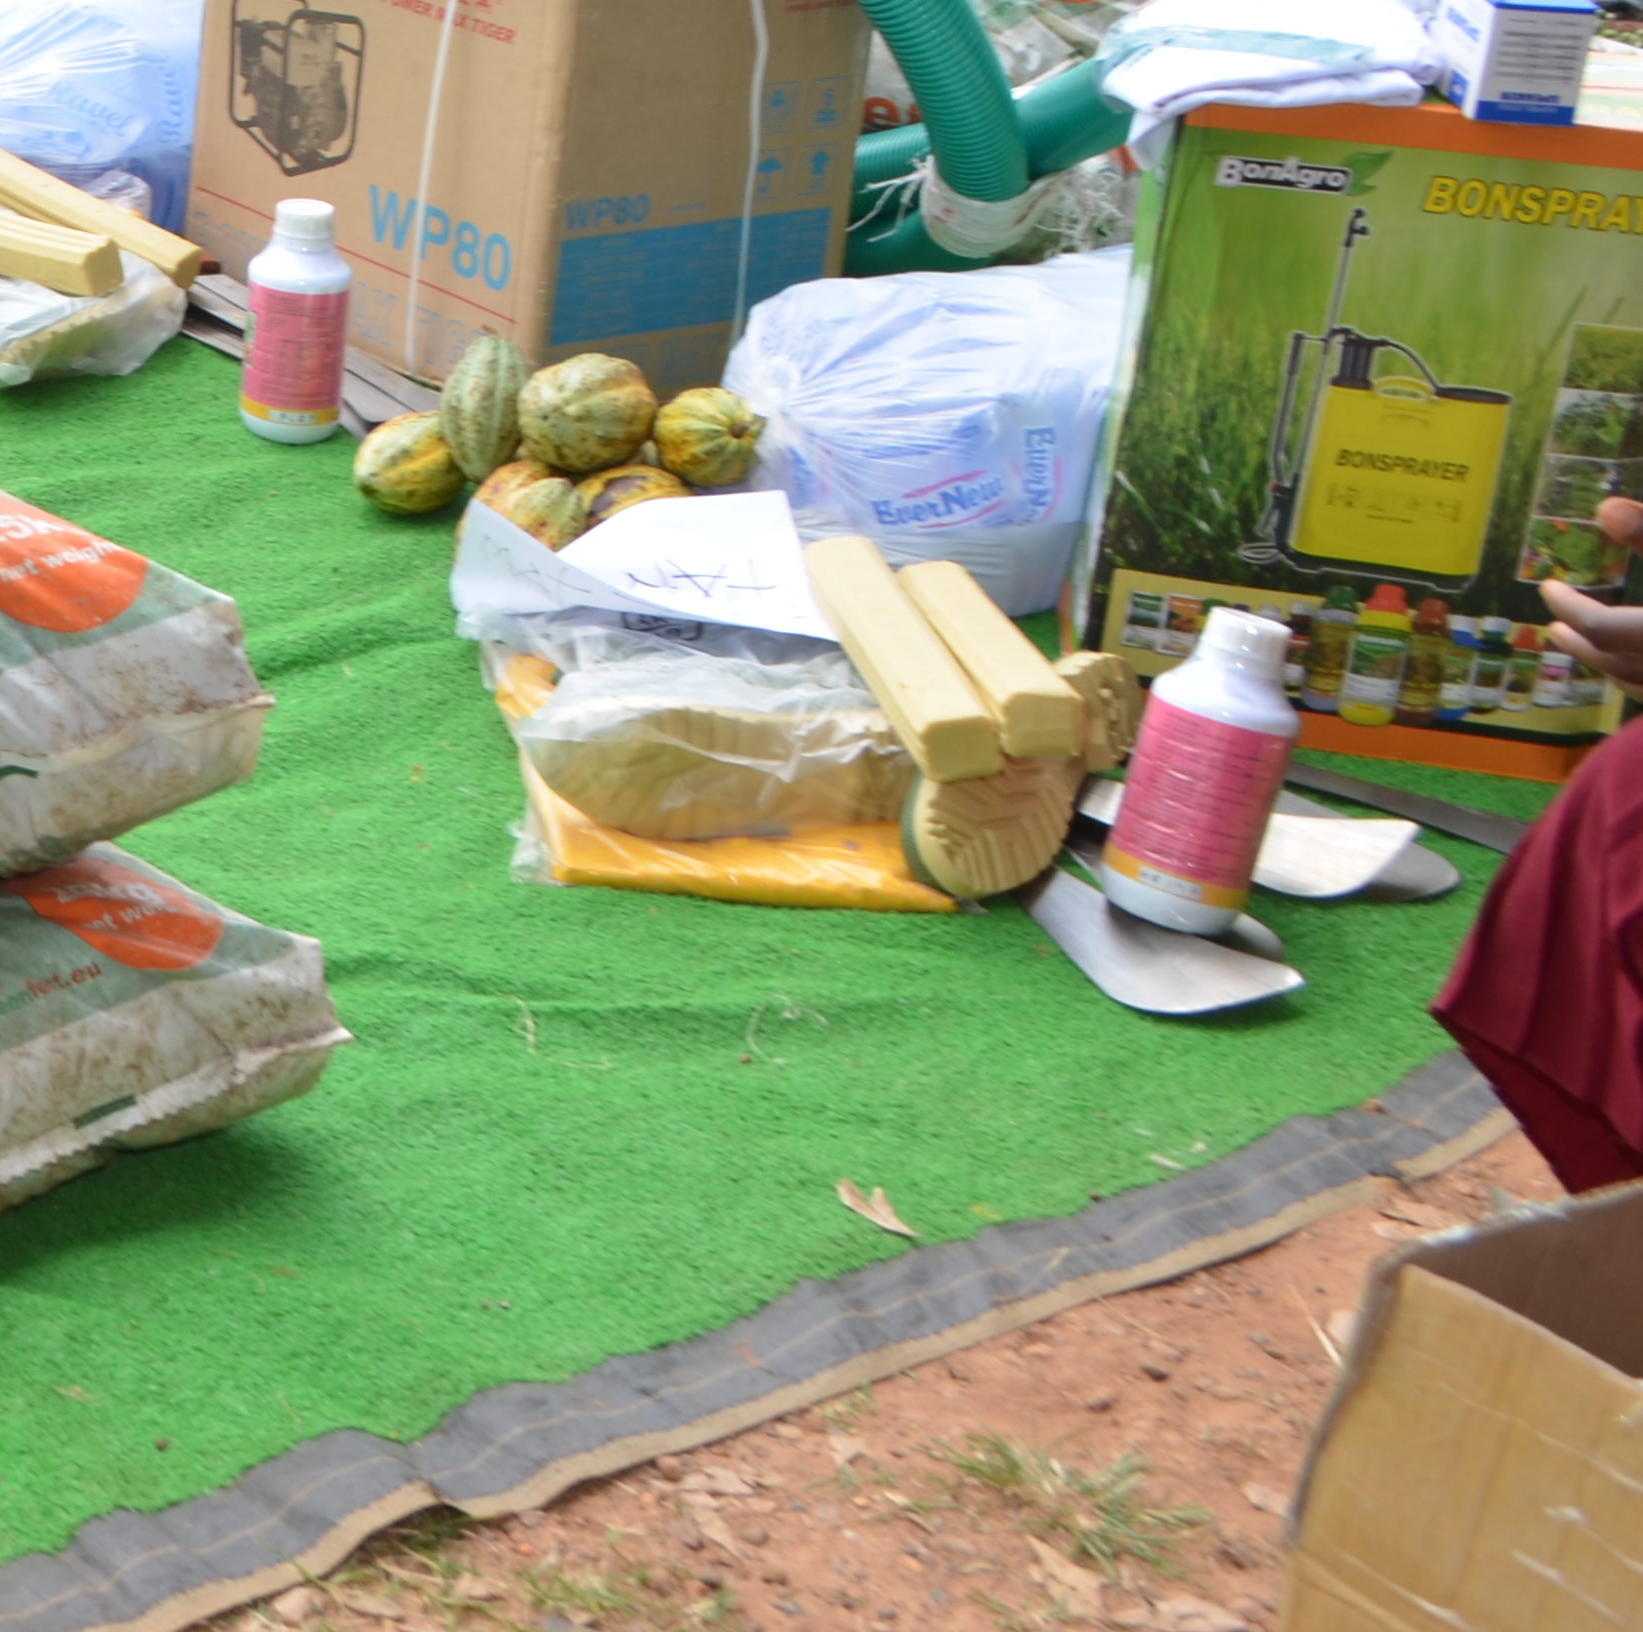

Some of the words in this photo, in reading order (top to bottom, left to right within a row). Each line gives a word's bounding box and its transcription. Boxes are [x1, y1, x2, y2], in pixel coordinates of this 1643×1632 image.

[471, 15, 518, 45] TIGER
[1216, 155, 1352, 195] BonAgro
[565, 194, 651, 231] WP80
[368, 182, 513, 292] WP80
[1335, 448, 1471, 484] BONSPRAYER
